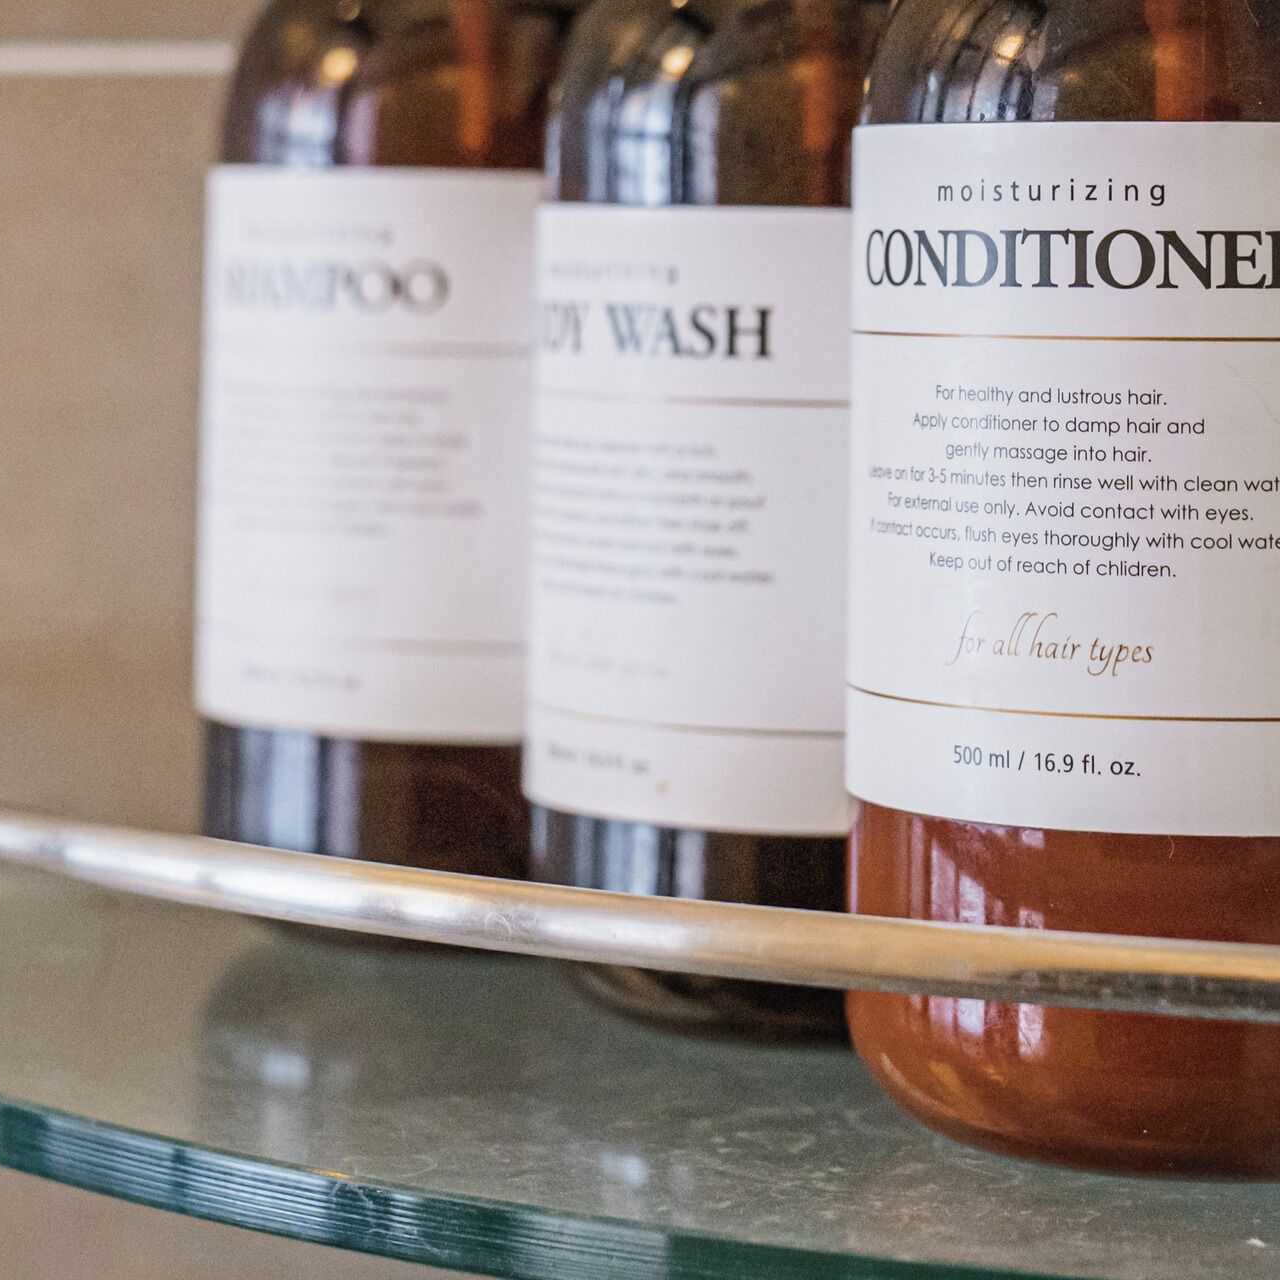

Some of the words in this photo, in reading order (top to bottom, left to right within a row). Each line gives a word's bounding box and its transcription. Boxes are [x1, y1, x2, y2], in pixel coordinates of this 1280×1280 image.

[938, 178, 1165, 207] moisturizing
[605, 300, 774, 361] WASH
[936, 384, 955, 400] For
[959, 386, 1013, 406] healthy
[1019, 388, 1051, 403] and
[1058, 388, 1121, 405] lustrous
[1128, 389, 1167, 405] hair.
[913, 412, 947, 430] Apply
[952, 415, 1038, 431] conditioner
[1043, 417, 1059, 432] to
[1065, 417, 1120, 436] damp
[1127, 418, 1161, 434] hair
[1167, 419, 1204, 434] and
[945, 442, 989, 461] gently
[994, 447, 1068, 464] massage
[1074, 445, 1106, 461] into
[1113, 446, 1151, 462] hair.
[910, 466, 925, 482] for
[928, 467, 947, 484] 3-5
[951, 469, 1006, 487] minutes
[1011, 472, 1048, 488] then
[1053, 473, 1092, 490] rinse
[1098, 475, 1133, 490] well
[1139, 475, 1177, 491] with
[1184, 476, 1238, 492] clean
[888, 491, 902, 508] For
[904, 496, 951, 512] external
[955, 501, 979, 513] use
[984, 500, 1019, 519] only.
[1025, 502, 1074, 518] Avoid
[1080, 504, 1154, 520] contact
[1161, 504, 1199, 520] with
[1205, 508, 1253, 524] eyes.
[877, 521, 913, 536] contact
[915, 525, 960, 541] occurs,
[965, 526, 996, 542] flush
[1002, 532, 1038, 547] eyes
[1044, 530, 1140, 551] thoroughly
[1146, 533, 1184, 548] with
[1190, 534, 1232, 549] cool
[930, 552, 964, 571] Keep
[968, 556, 992, 570] out
[997, 556, 1012, 572] of
[1017, 559, 1067, 574] reach
[1073, 559, 1090, 575] of
[946, 610, 985, 665] for
[993, 612, 1039, 658] all
[1028, 612, 1081, 659] hair
[1087, 638, 1152, 677] types
[954, 745, 982, 766] 500
[989, 750, 1010, 768] ml
[1018, 751, 1025, 771] /
[1035, 753, 1074, 773] 16.9
[1082, 754, 1101, 775] fl.
[1110, 761, 1140, 776] oz.
